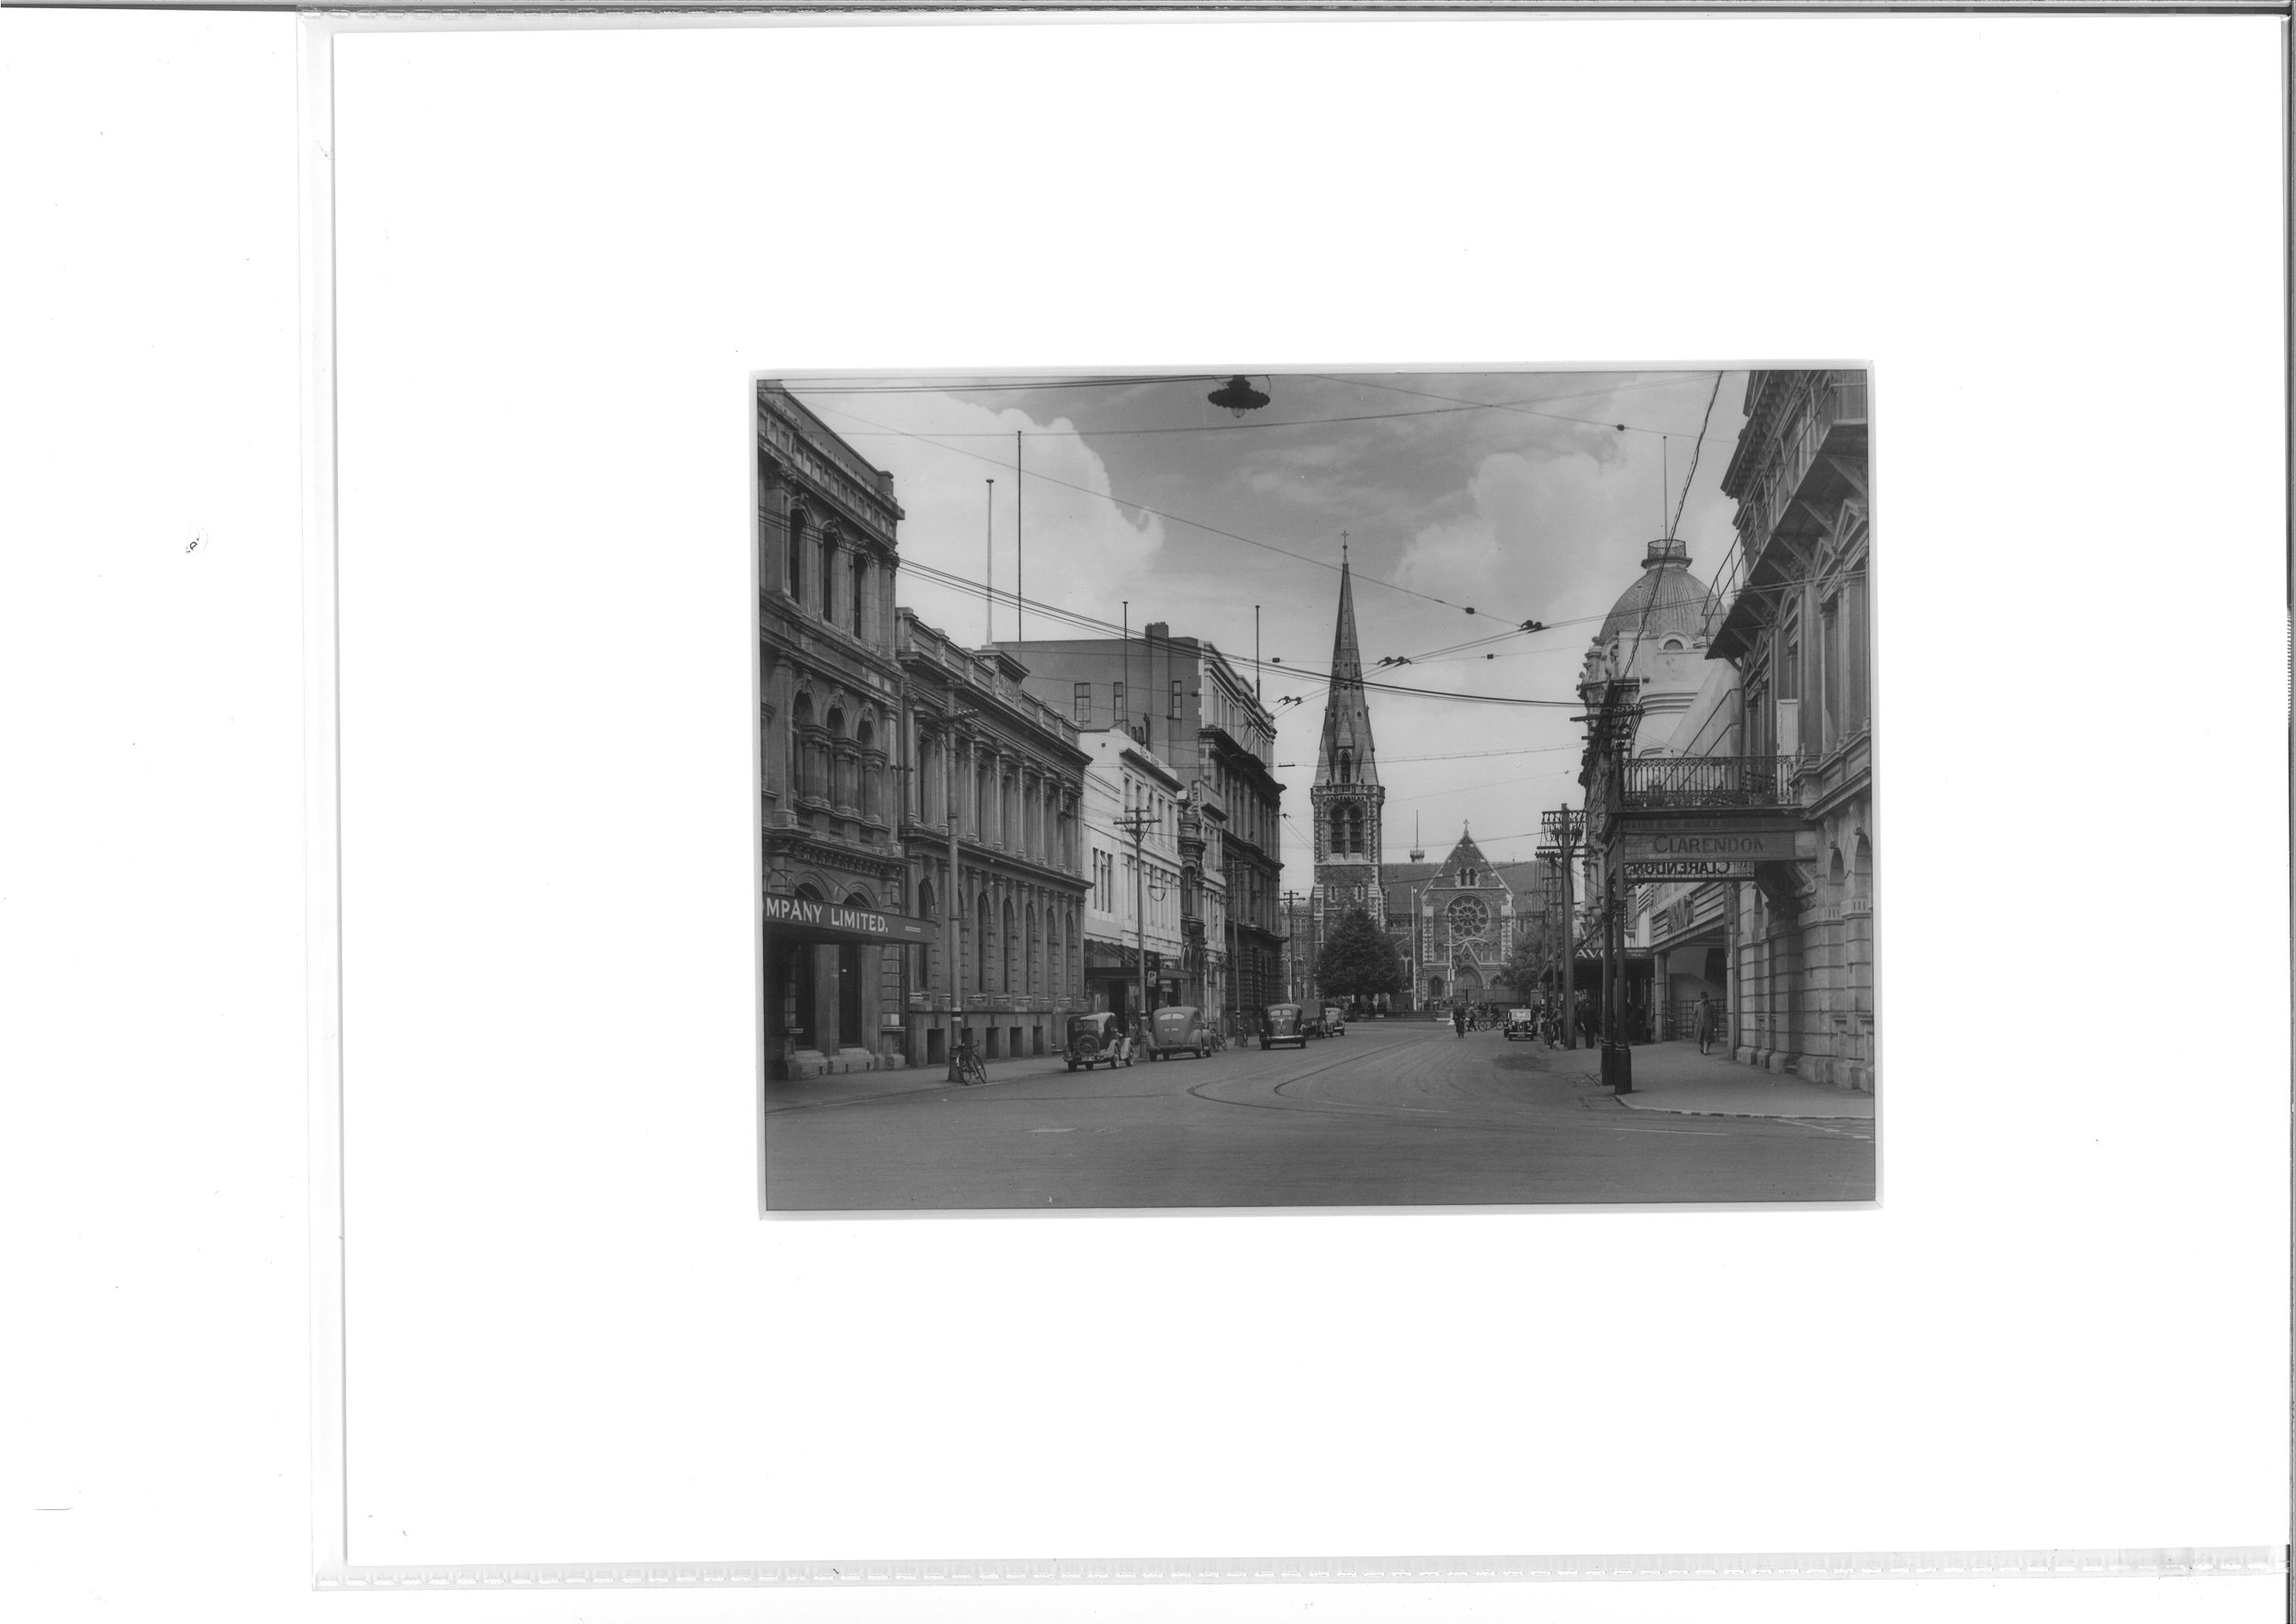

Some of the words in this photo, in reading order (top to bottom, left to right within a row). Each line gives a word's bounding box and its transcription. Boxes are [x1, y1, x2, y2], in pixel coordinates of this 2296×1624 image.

[1653, 835, 1763, 853] CLARENDON
[764, 897, 822, 923] MPANY
[831, 908, 888, 933] LIMITED.
